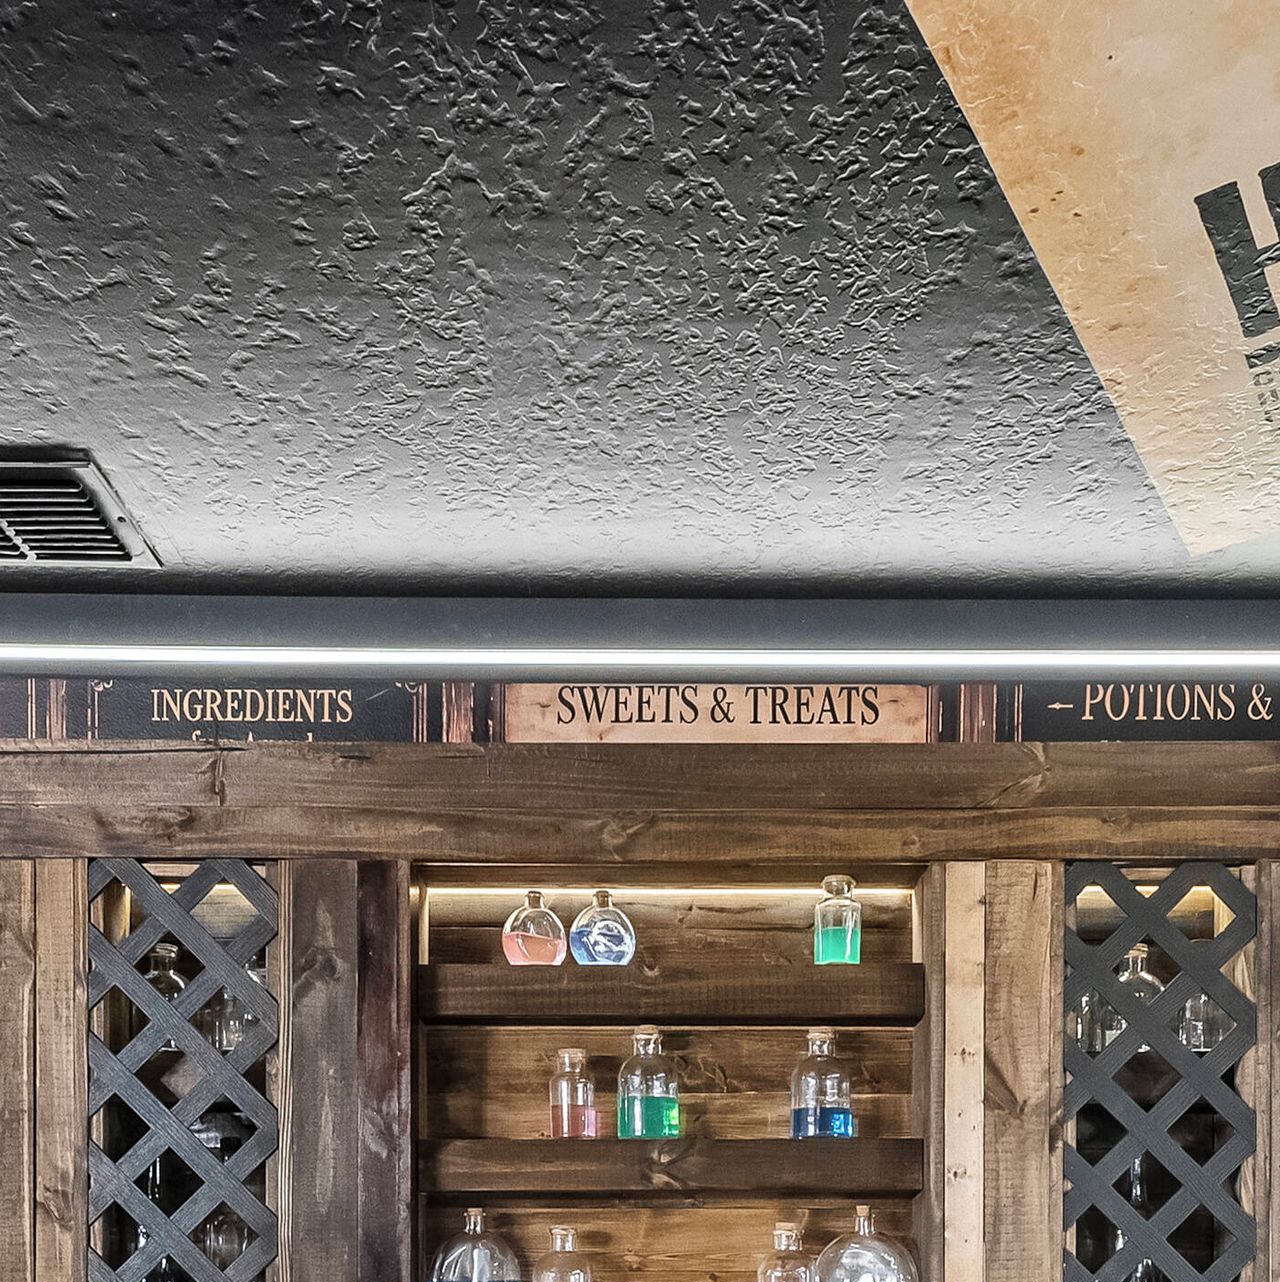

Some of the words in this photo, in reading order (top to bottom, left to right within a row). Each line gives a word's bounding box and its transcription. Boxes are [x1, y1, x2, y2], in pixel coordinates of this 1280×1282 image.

[150, 688, 354, 723] INGREDIENTS
[556, 684, 700, 725] SWEETS
[710, 685, 736, 724] &
[745, 685, 880, 726] TREATS
[1081, 683, 1236, 722] POTIONS
[1246, 683, 1274, 722] &
